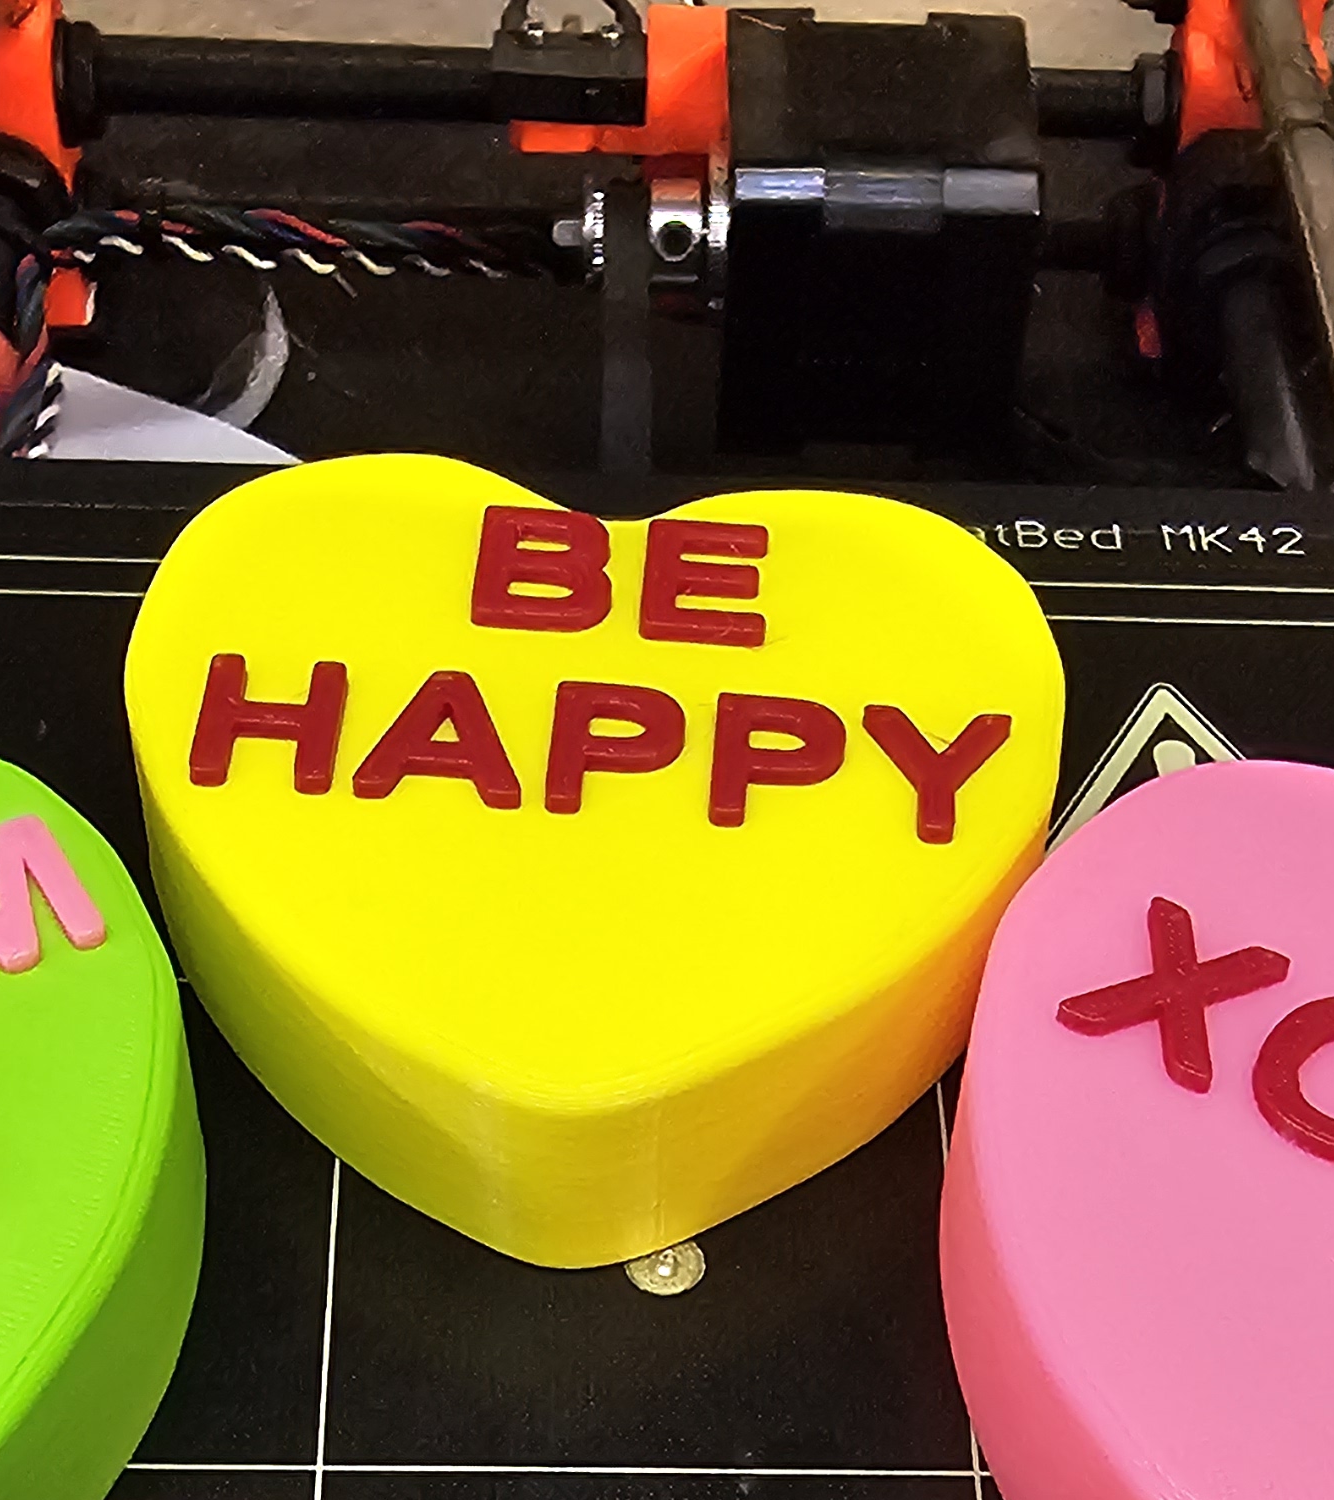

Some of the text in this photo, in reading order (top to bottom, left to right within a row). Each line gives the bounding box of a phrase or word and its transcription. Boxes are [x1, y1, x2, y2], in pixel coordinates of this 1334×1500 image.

[470, 504, 769, 648] BE
[1159, 522, 1306, 557] MK42
[189, 652, 1013, 844] HAPPY
